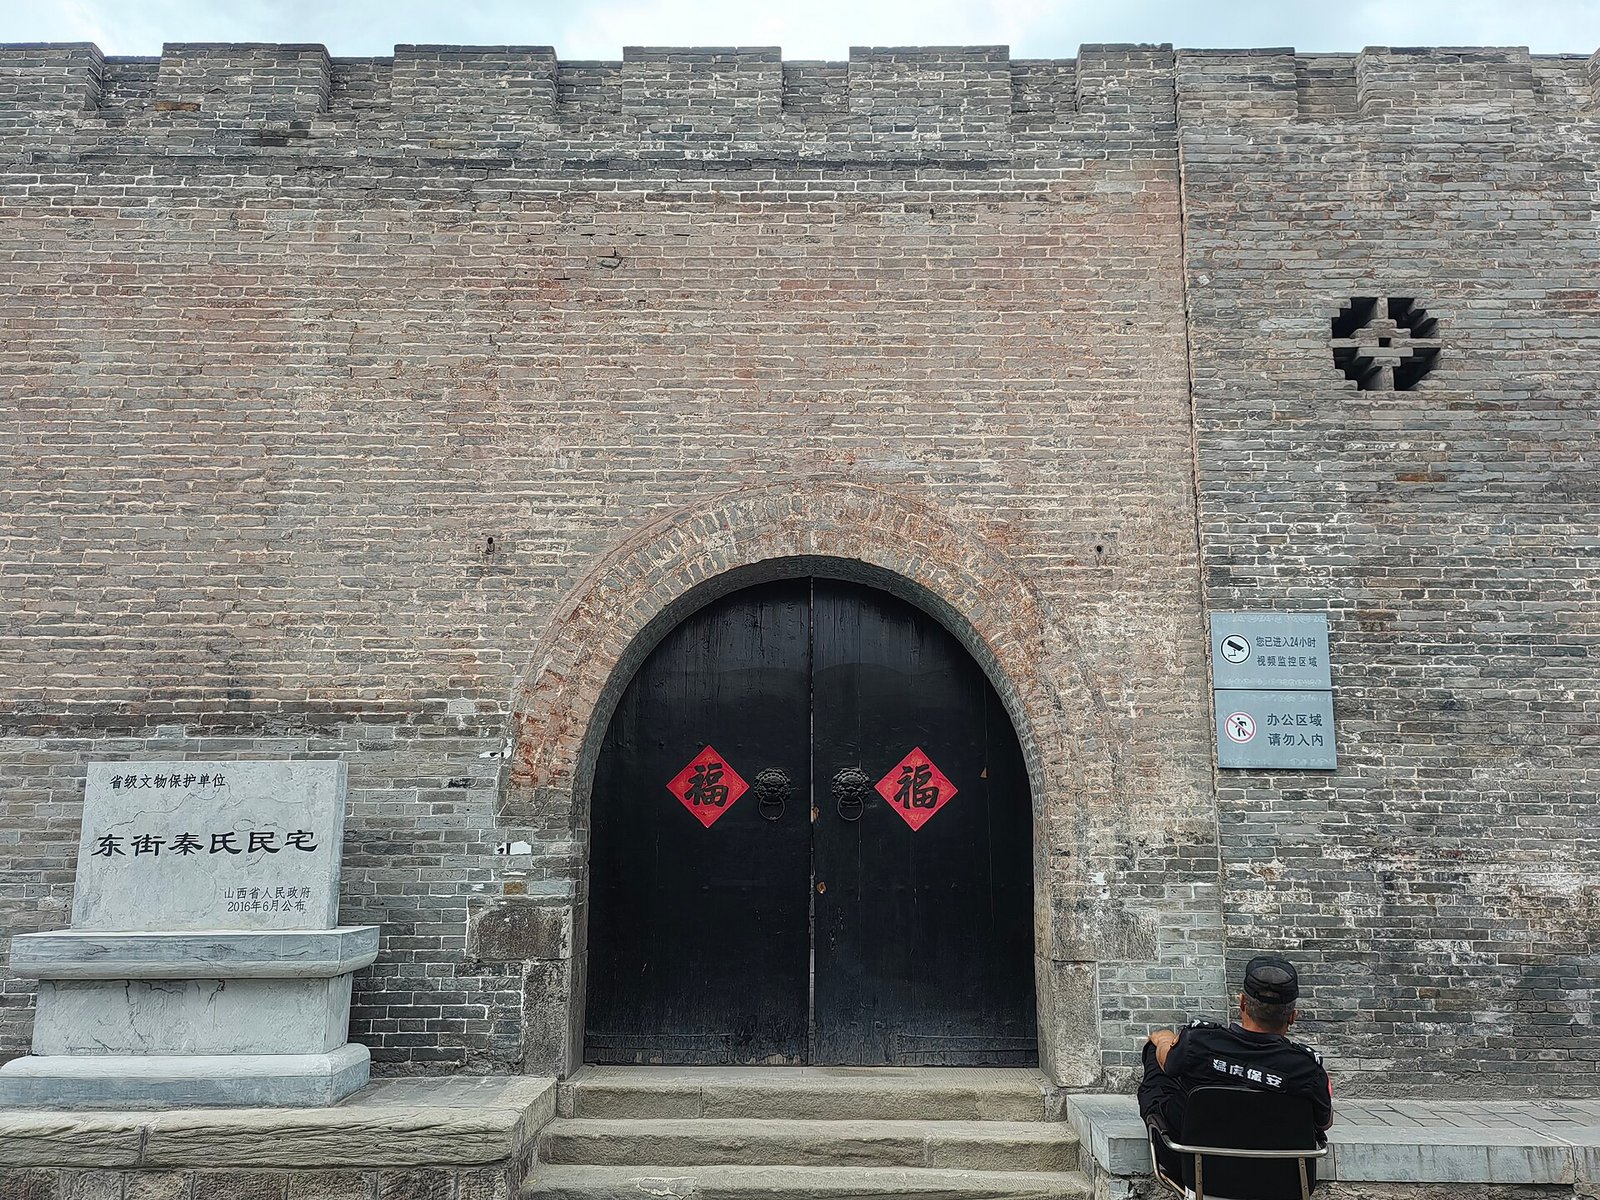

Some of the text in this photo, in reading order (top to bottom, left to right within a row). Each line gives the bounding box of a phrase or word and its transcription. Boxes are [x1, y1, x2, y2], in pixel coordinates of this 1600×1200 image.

[1255, 636, 1316, 648] 您已进入24小时
[1256, 655, 1318, 667] 视频监控区域
[1266, 713, 1323, 727] 办公区域
[1267, 733, 1324, 747] 请勿入内
[110, 773, 226, 789] 省级文物保护单位
[684, 763, 729, 806] 福
[895, 764, 939, 809] 福
[91, 830, 318, 856] 东街秦氏民宅
[224, 887, 311, 899] 山西省人民政府
[227, 900, 305, 912] 2016年6月公布
